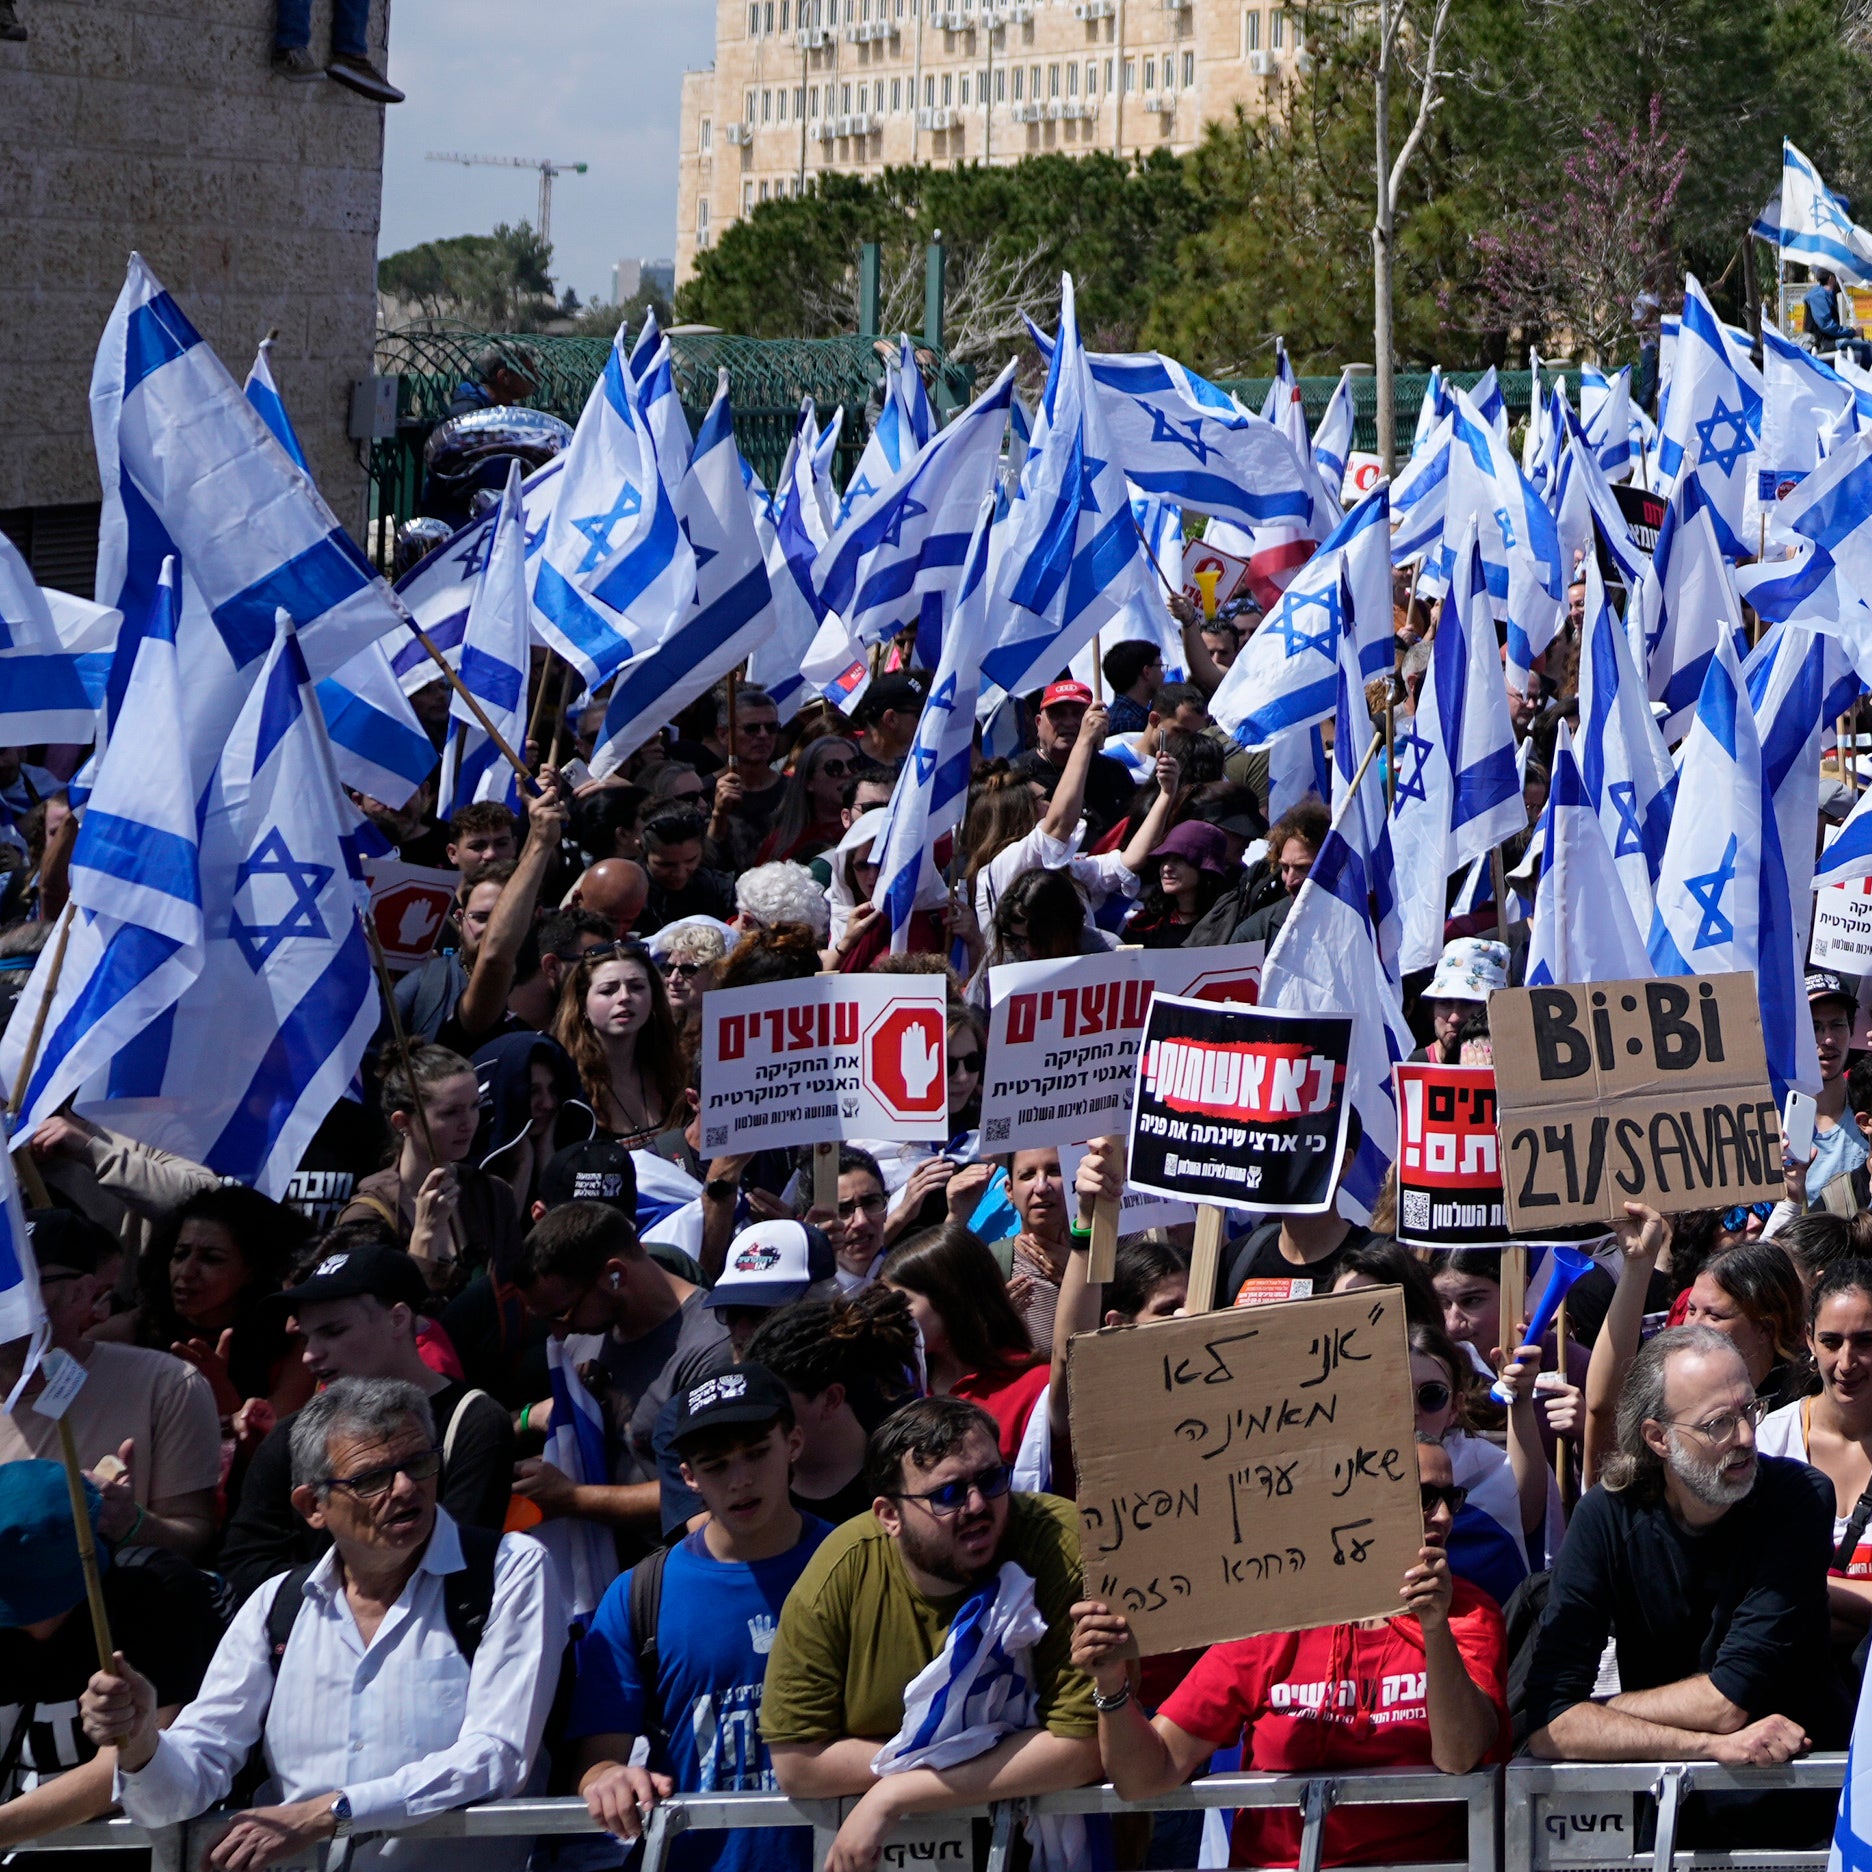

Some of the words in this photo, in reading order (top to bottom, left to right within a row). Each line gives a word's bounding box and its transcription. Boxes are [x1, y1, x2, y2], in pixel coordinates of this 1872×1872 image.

[1831, 938, 1854, 952] השלטון
[1005, 980, 1155, 1045] עוצרים
[718, 1002, 859, 1061] עוצרים
[1530, 982, 1725, 1080] Bi:Bi
[755, 1057, 828, 1080] החקיקה
[834, 1056, 859, 1069] את
[1044, 1042, 1113, 1070] החקיקה
[806, 1077, 860, 1093] האנטי
[991, 1070, 1088, 1099] דמוקרטית
[1093, 1064, 1137, 1083] אנטי
[1146, 1040, 1266, 1109] אשתוק!
[1269, 1055, 1336, 1113] לא
[709, 1081, 800, 1110] דמוקרטית
[1056, 1099, 1087, 1119] לאיכות
[1089, 1093, 1119, 1112] התנועה
[734, 1112, 769, 1131] השלטון
[771, 1106, 802, 1124] לאיכות
[804, 1104, 839, 1119] התנועה
[1017, 1105, 1054, 1125] השלטון
[1140, 1114, 1168, 1135] פניה
[1168, 1121, 1188, 1141] את
[1191, 1124, 1246, 1147] שינתה
[1249, 1130, 1297, 1152] ארצי
[1305, 1135, 1326, 1152] כי
[1511, 1101, 1784, 1208] 24/SAVAGE
[1433, 1203, 1487, 1229] השלטון
[1164, 1330, 1259, 1392] לא
[1175, 1394, 1337, 1460] מאמינה
[1332, 1446, 1405, 1497] שאני
[1228, 1461, 1298, 1544] עדיין
[1082, 1483, 1199, 1552] מפגינה
[1331, 1518, 1375, 1565] על
[1223, 1548, 1306, 1584] החרא
[1270, 1680, 1356, 1708] הנשים
[1382, 1672, 1427, 1707] אבק
